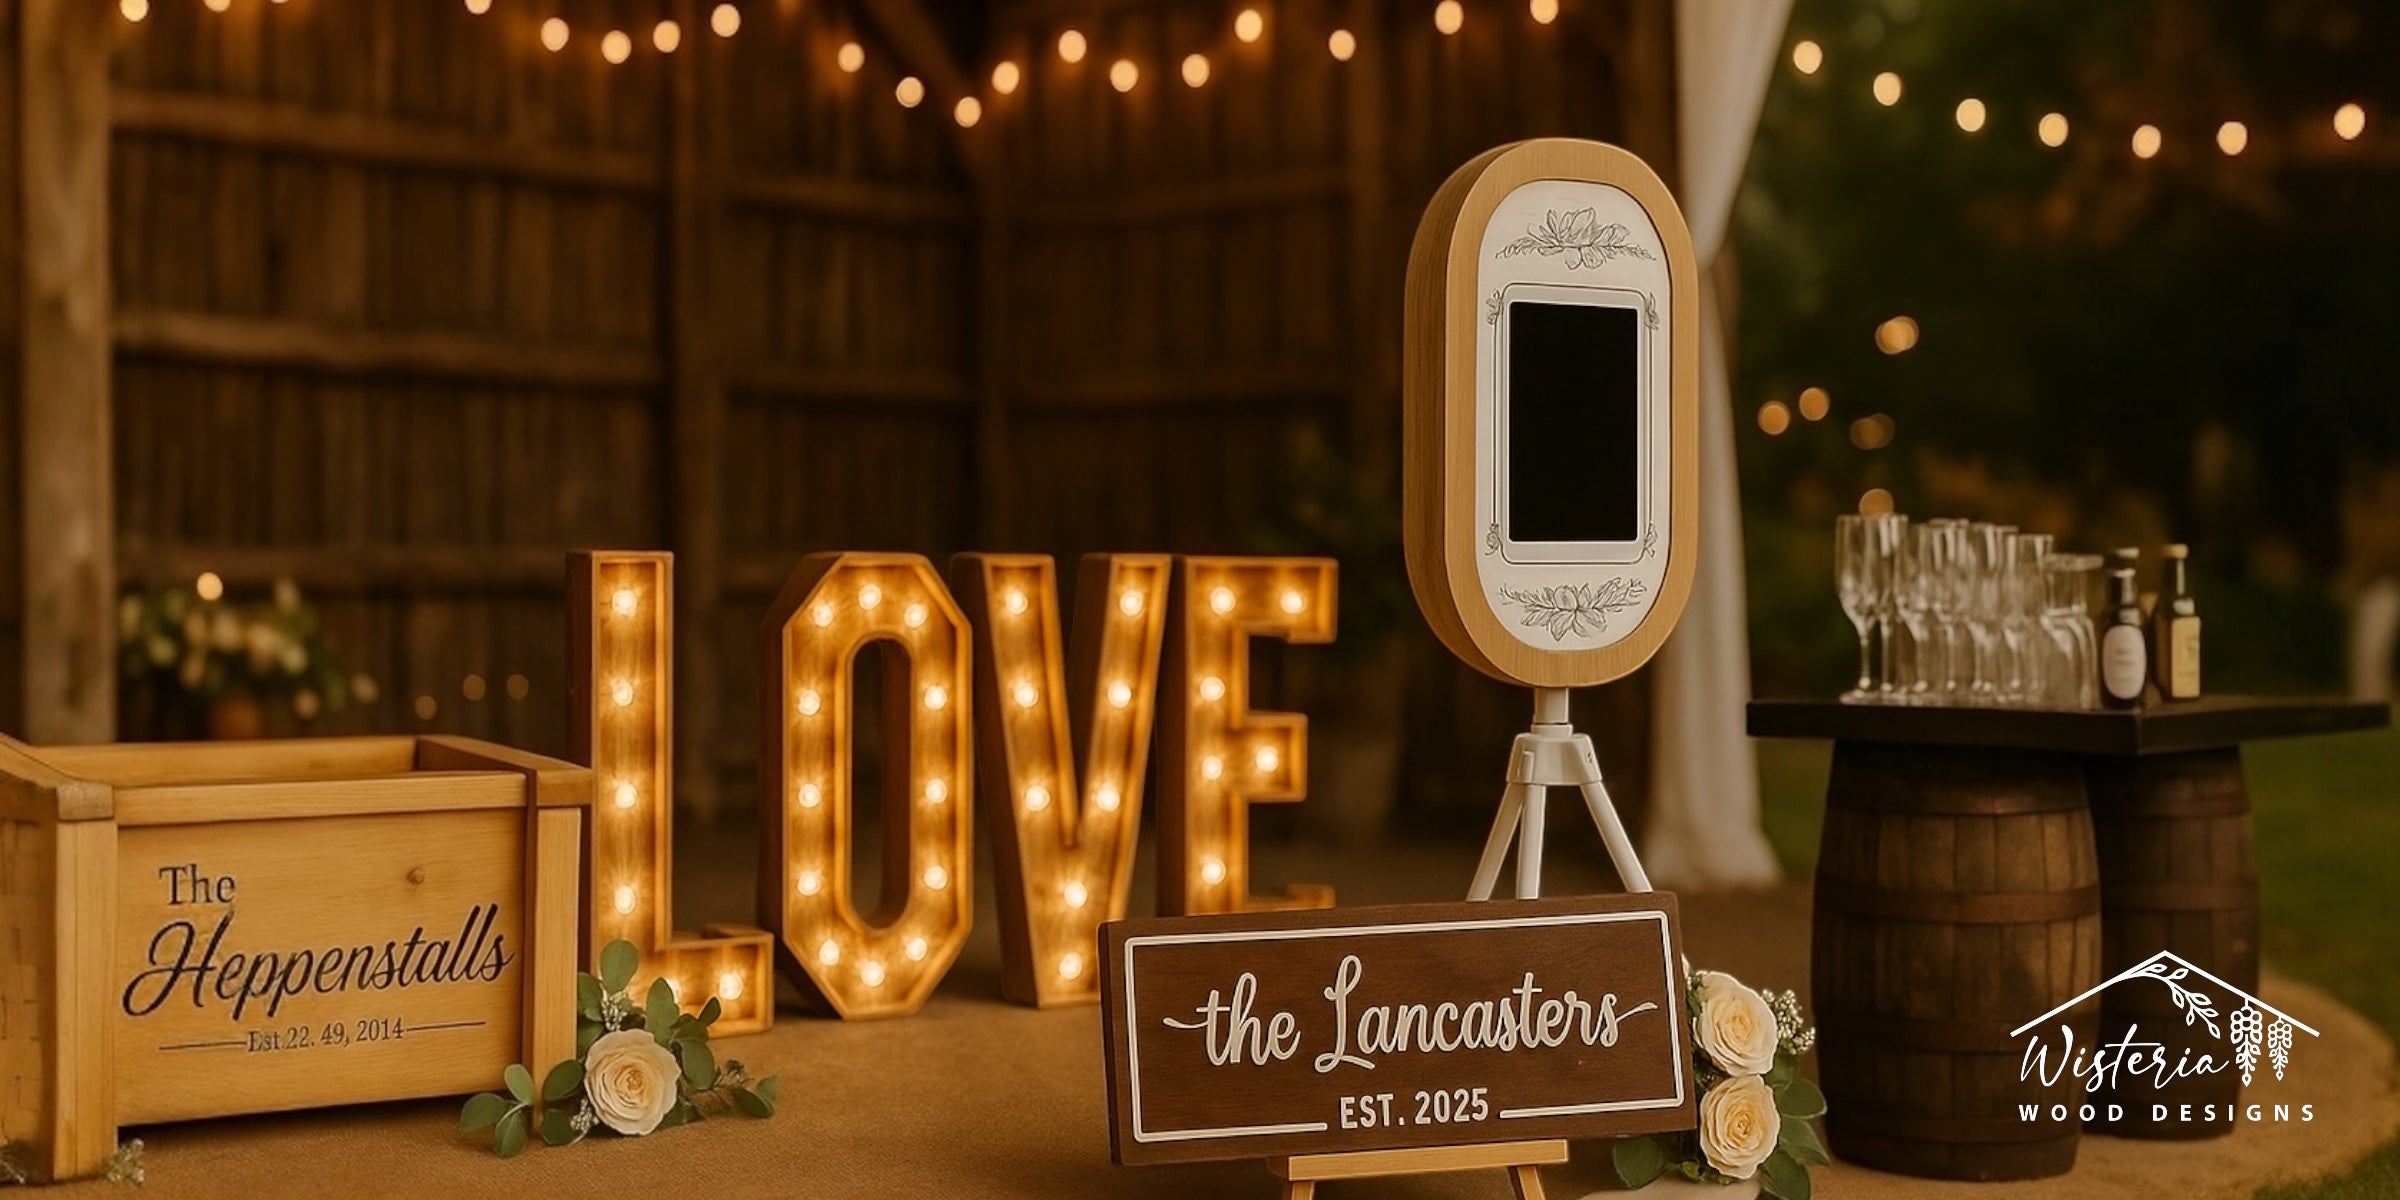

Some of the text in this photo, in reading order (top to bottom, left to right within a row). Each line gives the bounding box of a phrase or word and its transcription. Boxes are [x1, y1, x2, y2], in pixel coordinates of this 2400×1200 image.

[567, 551, 1338, 1036] LOVE
[159, 864, 235, 905] The
[122, 903, 514, 1020] Heppenstalls
[320, 1022, 350, 1048] 49,
[356, 1017, 404, 1042] 2014
[1163, 954, 1658, 1074] the Lancasters
[1340, 1087, 1489, 1129] EST. 2025
